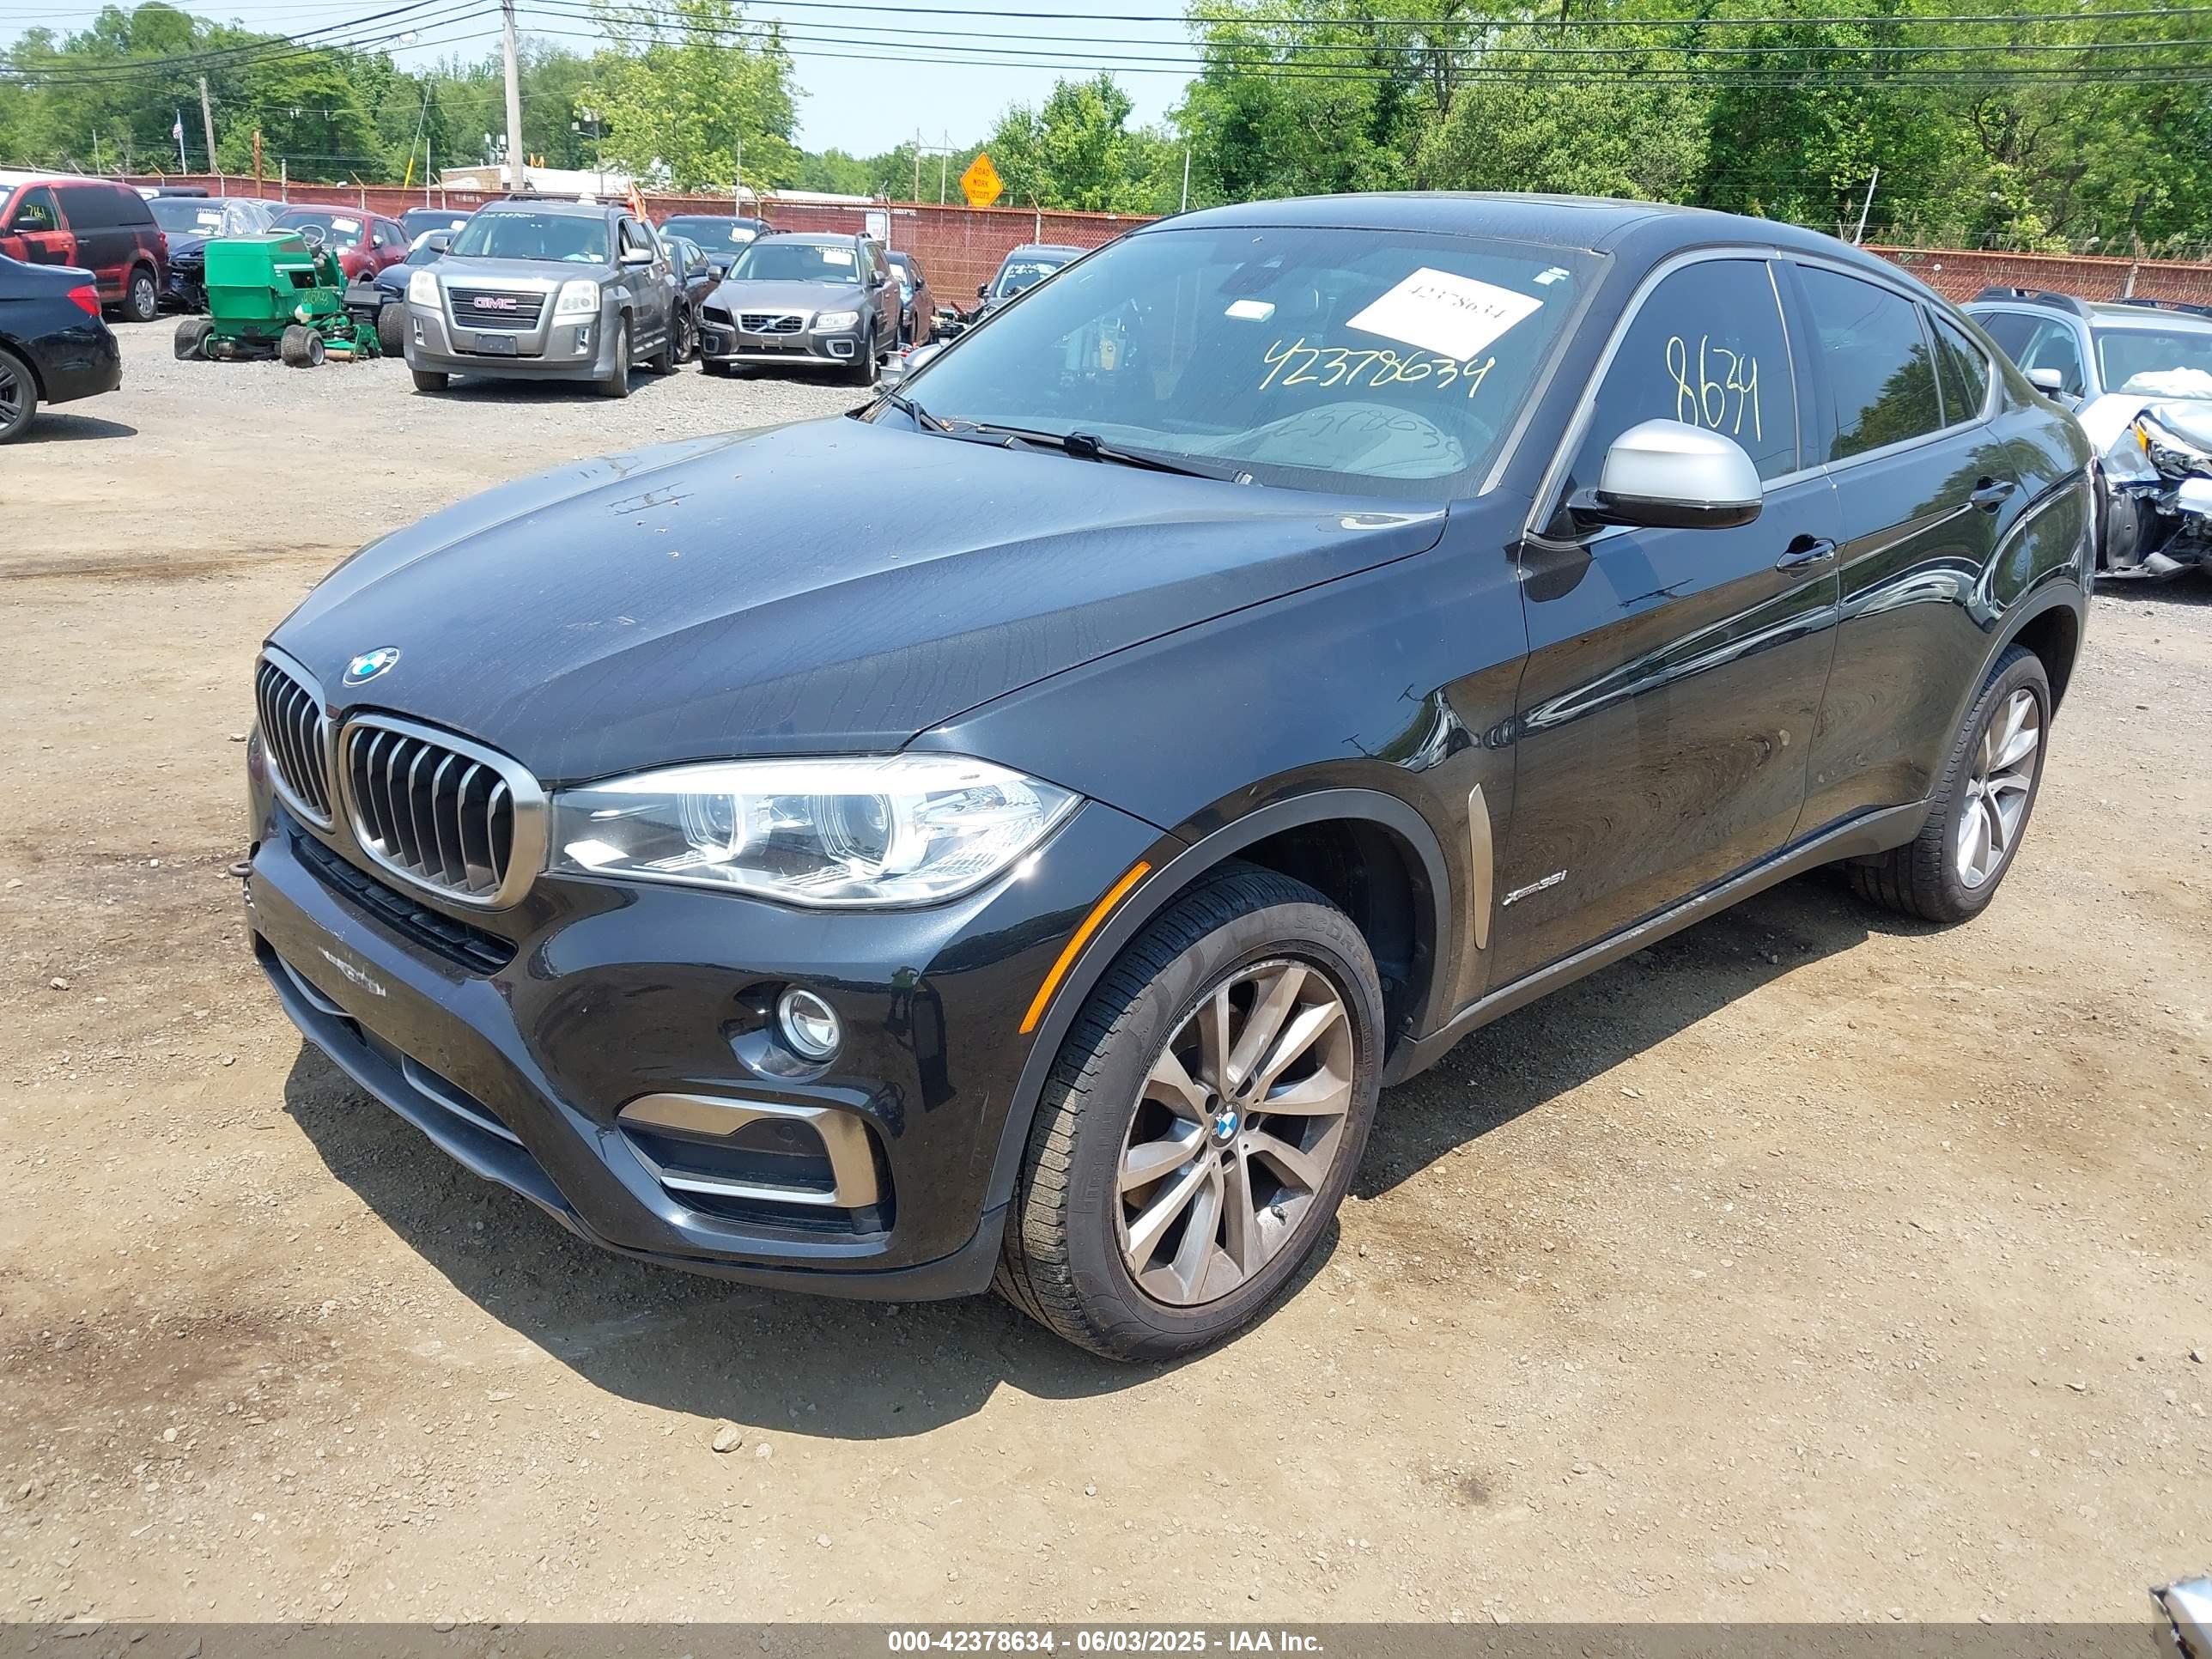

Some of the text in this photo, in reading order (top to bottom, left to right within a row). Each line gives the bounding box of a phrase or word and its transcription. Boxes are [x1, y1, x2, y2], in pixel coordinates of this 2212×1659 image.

[974, 167, 990, 176] ROAD
[973, 179, 989, 187] WORK
[473, 296, 517, 310] GMC
[1258, 337, 1497, 398] 42378634
[1666, 333, 1764, 443] 8634
